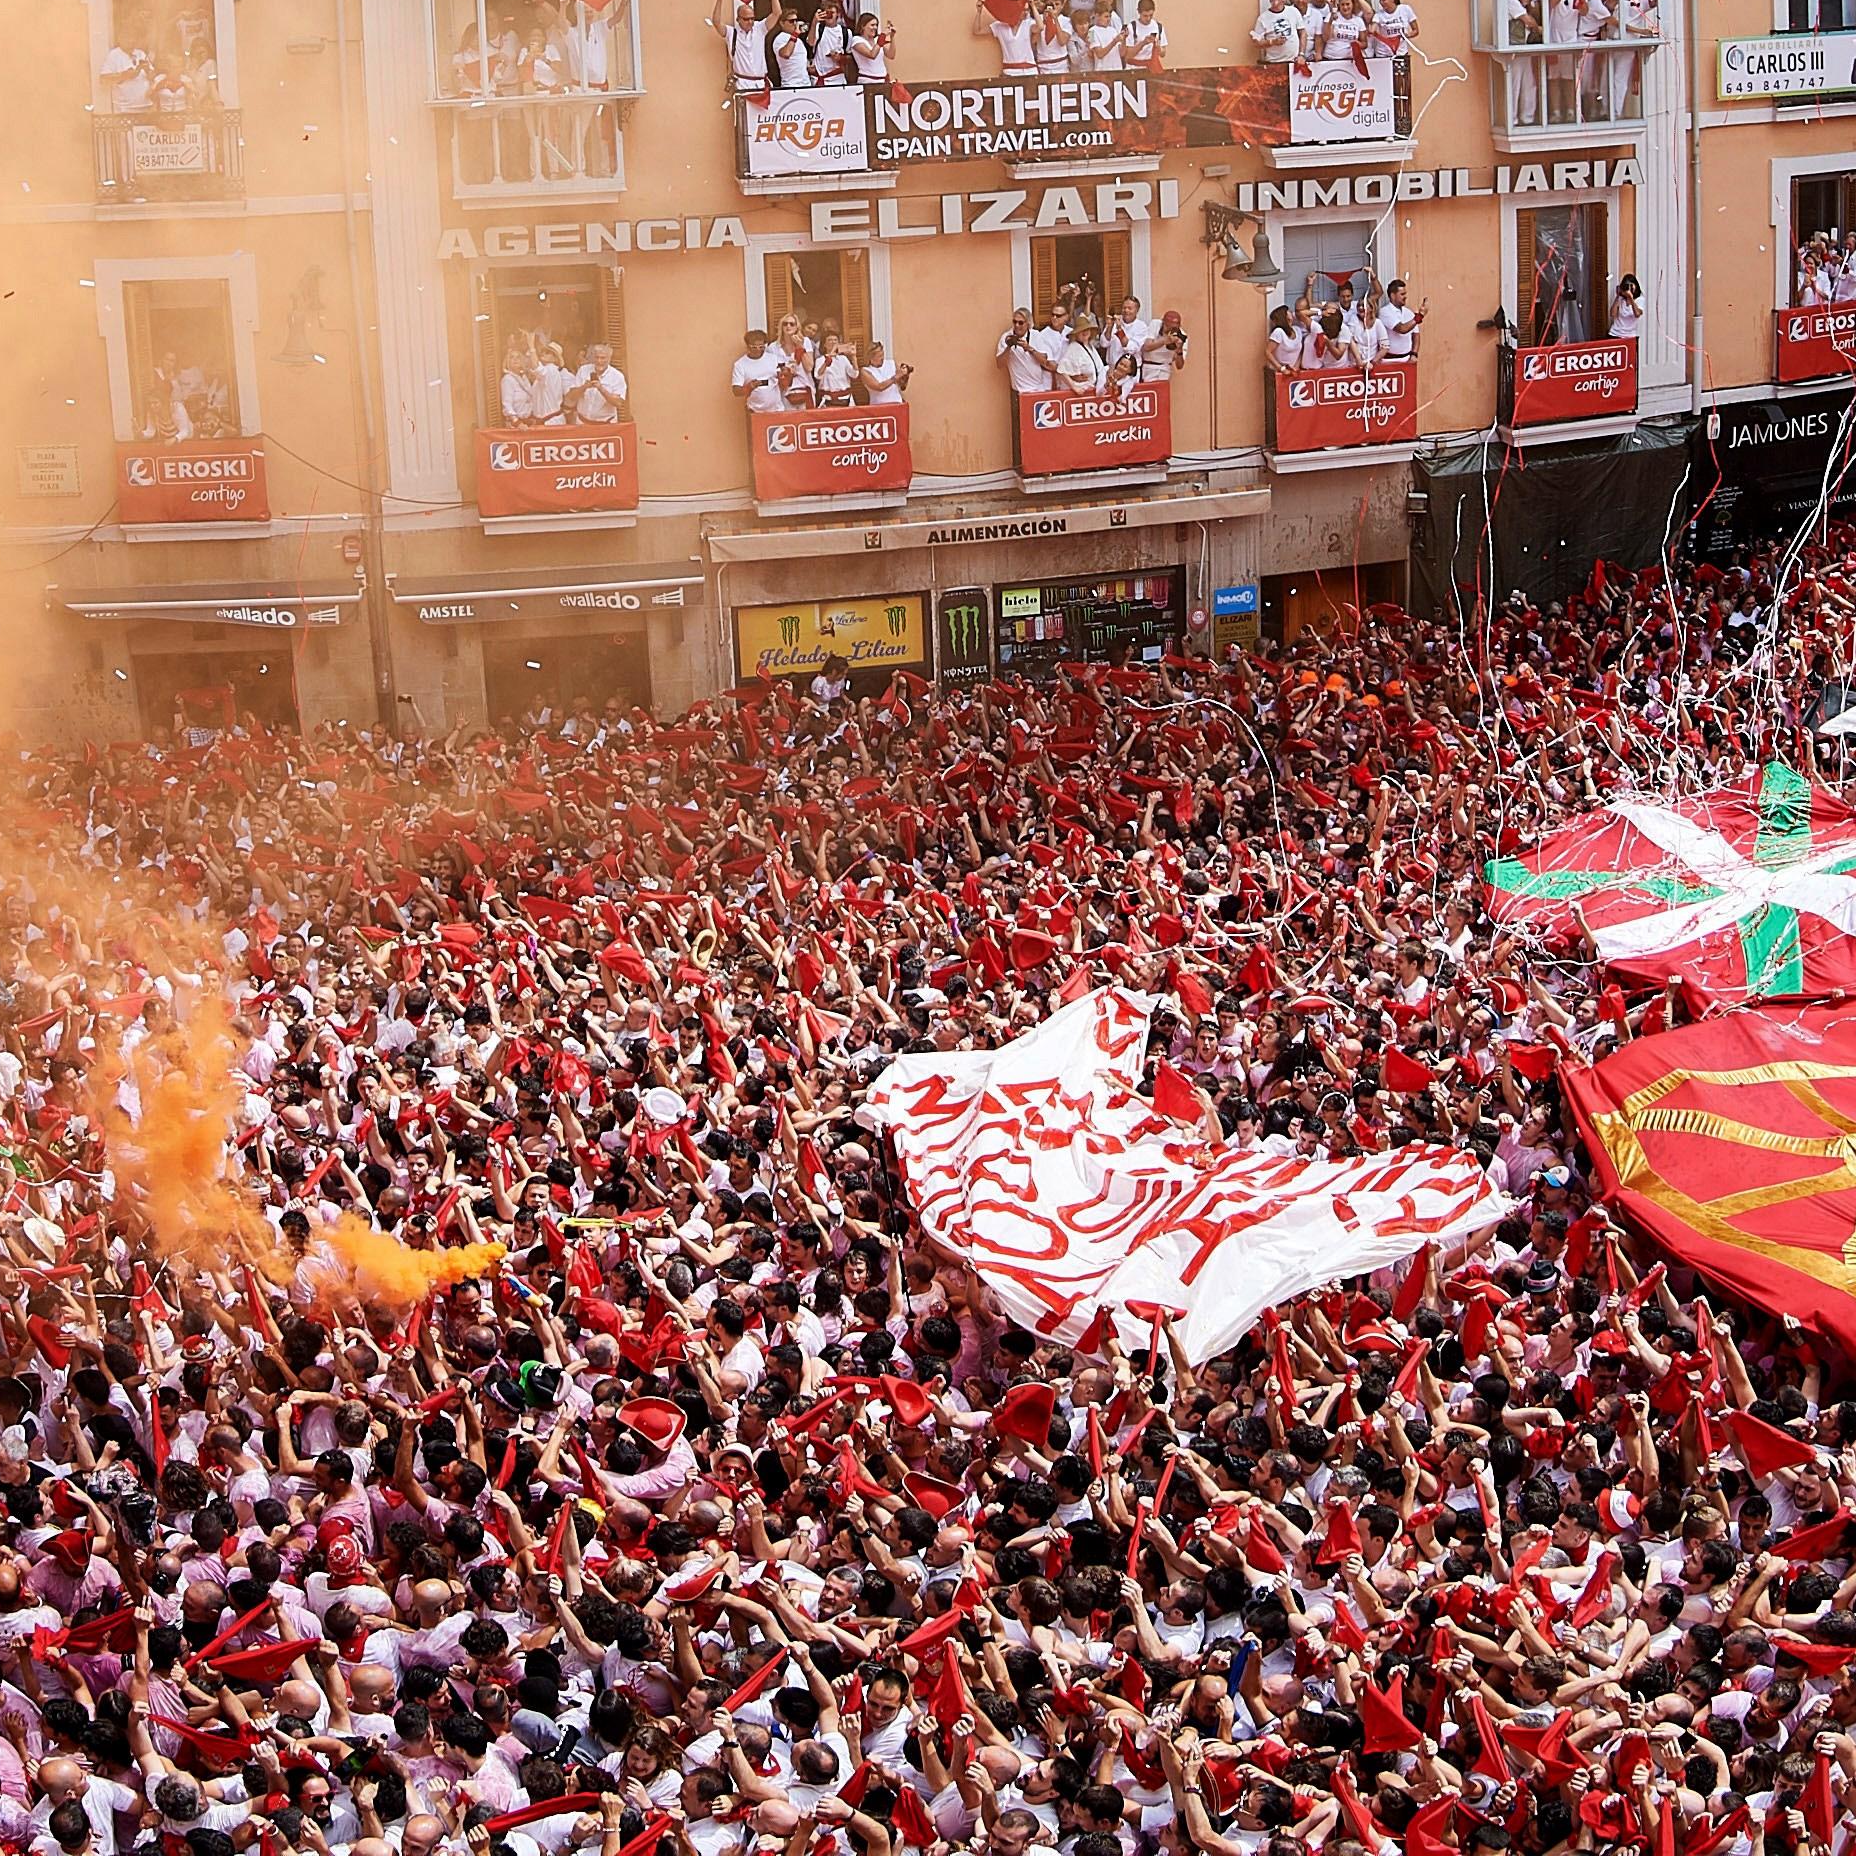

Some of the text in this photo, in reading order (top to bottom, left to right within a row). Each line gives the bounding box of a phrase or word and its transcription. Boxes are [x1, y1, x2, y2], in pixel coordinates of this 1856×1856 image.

[1746, 50, 1825, 76] CARLOS III
[1297, 81, 1355, 93] Luminosos
[1725, 76, 1825, 94] 649 847 747
[874, 79, 1148, 134] NORTHERN
[1294, 88, 1375, 119] ARGA
[756, 111, 822, 124] Luminosos
[1352, 109, 1390, 127] digital
[754, 118, 845, 150] ARGA
[876, 128, 1114, 160] SPAIN TRAVEL.com
[819, 140, 863, 159] digital
[435, 157, 1646, 261] AGENCIA ELIZARI INMOBILIARIA
[1554, 350, 1622, 373] EROSKI
[1323, 377, 1399, 399] EROSKI
[1574, 374, 1619, 398] contigo
[1070, 396, 1150, 420] EROSKI
[1345, 400, 1397, 426] contigo
[805, 422, 890, 445] EROSKI
[1094, 425, 1151, 445] zurekin
[1728, 412, 1829, 449] JAMONES
[529, 442, 616, 463] EROSKI
[831, 447, 888, 474] contigo
[163, 459, 248, 479] EROSKI
[555, 472, 617, 490] zurekin
[191, 483, 246, 511] contigo
[927, 516, 1067, 544] ALIMENTACIÓN
[1327, 532, 1341, 553] 2
[418, 604, 475, 620] AMSTEL
[1219, 613, 1253, 625] ELIZARI
[846, 638, 910, 663] Lilian
[942, 664, 989, 679] MONSTER
